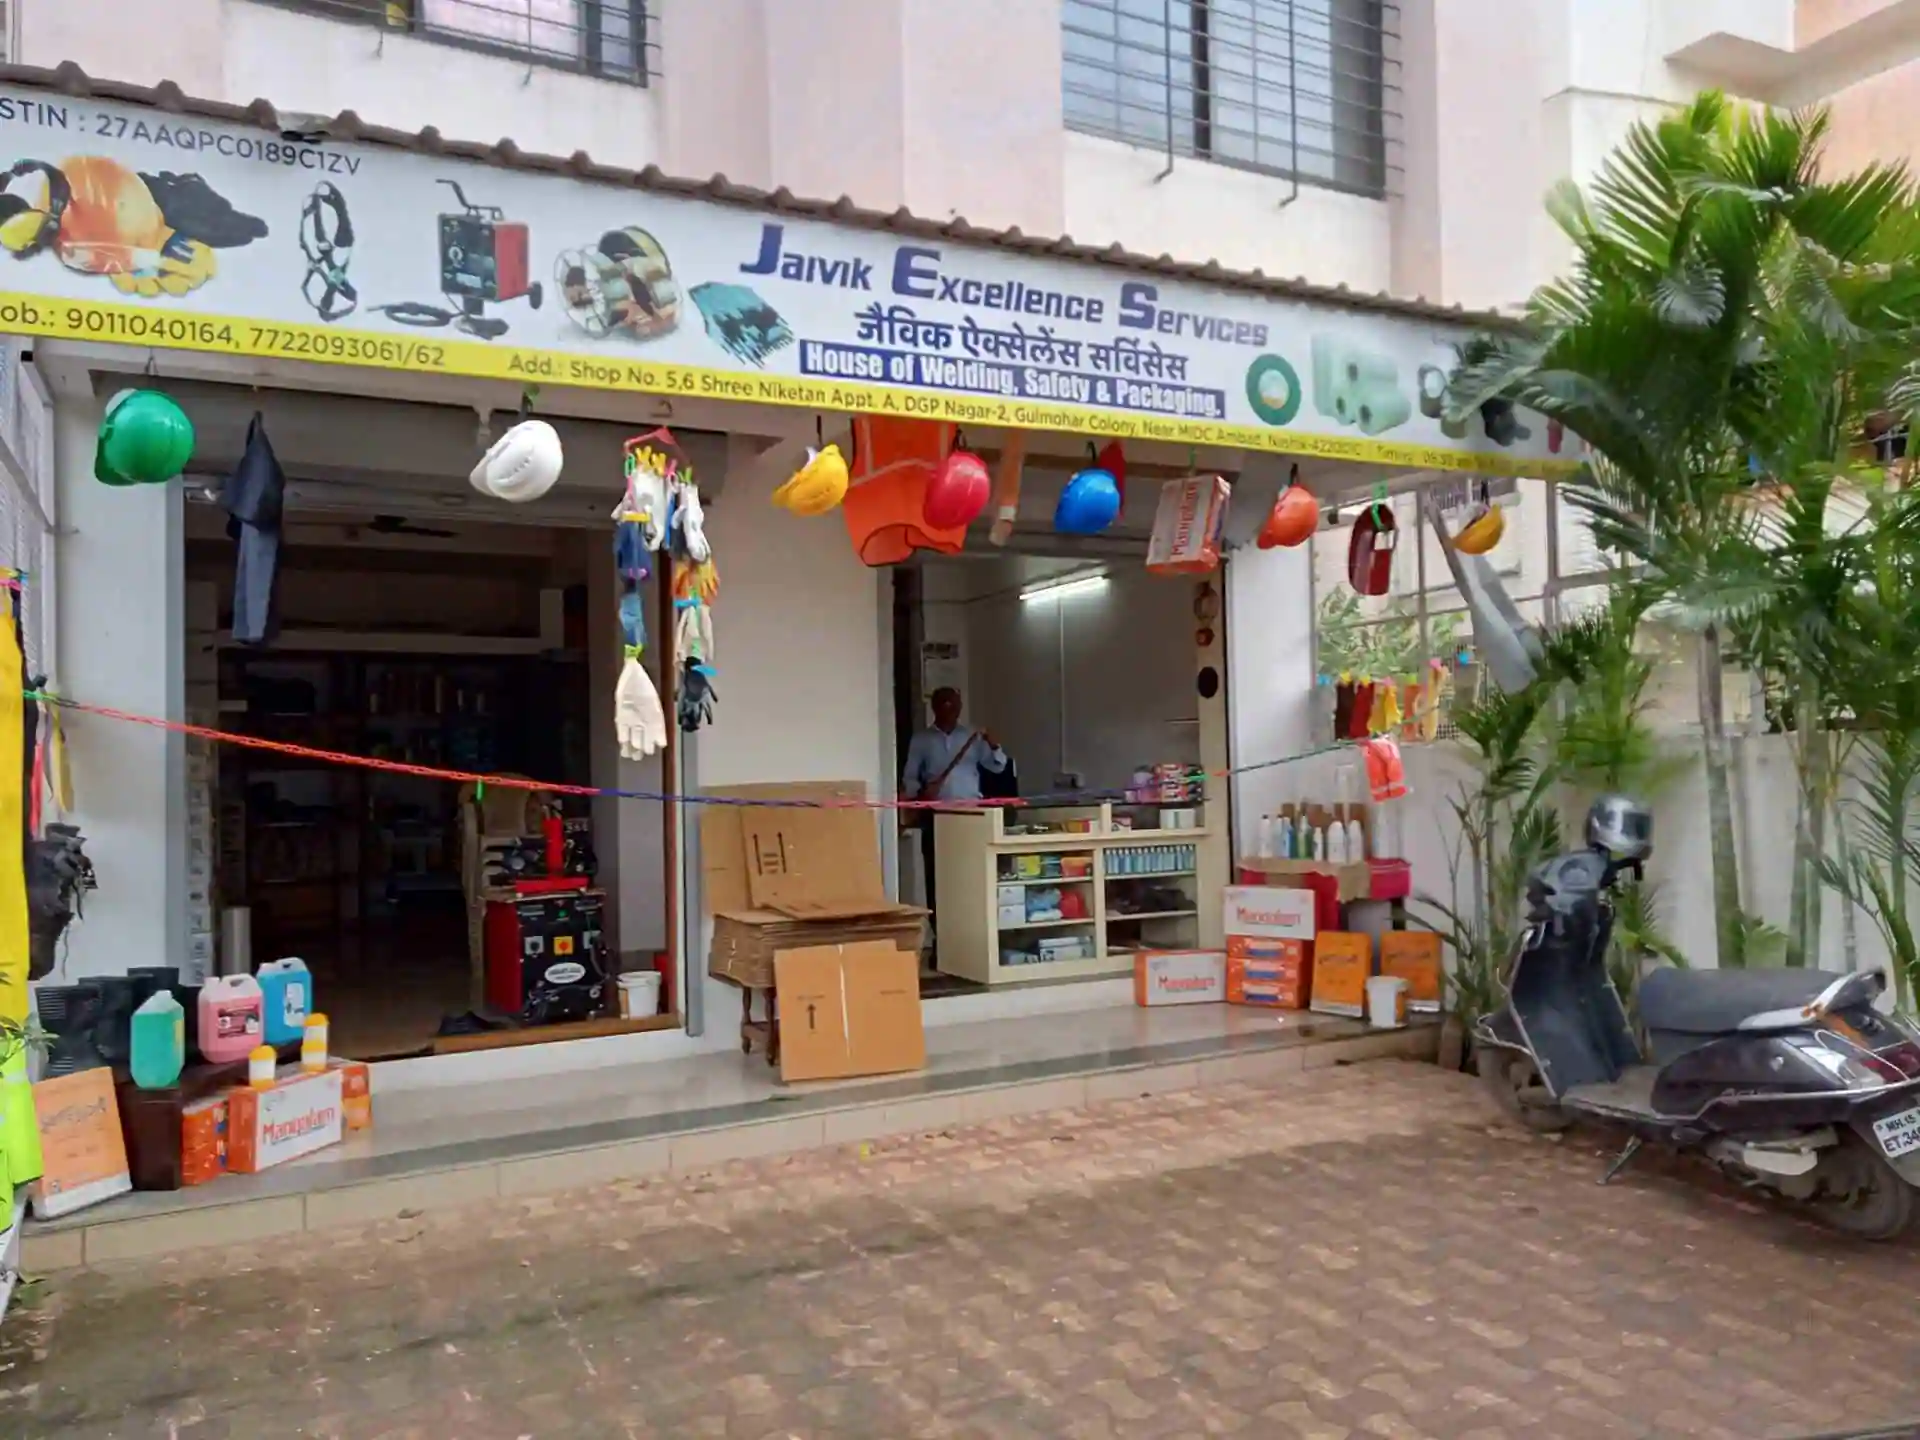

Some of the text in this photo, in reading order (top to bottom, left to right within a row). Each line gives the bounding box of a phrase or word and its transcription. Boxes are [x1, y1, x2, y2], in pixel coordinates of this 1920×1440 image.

[95, 113, 361, 175] 27AAQPC0189C1ZV
[739, 223, 1269, 347] Jaivik Excellence Services
[67, 308, 239, 348] 9011040164,
[250, 327, 444, 366] 7722093061/62
[854, 301, 1189, 381] जैविक ऐक्सेलेंस सर्विसेस
[570, 360, 621, 384] Shop
[627, 367, 661, 386] No.
[666, 370, 695, 391] 5,6
[701, 375, 753, 395] Shree
[759, 382, 826, 403] Niketan
[905, 395, 939, 413] DGP
[1015, 407, 1084, 427] Gulmohar
[806, 342, 884, 379] House
[890, 353, 915, 382] of
[1024, 368, 1090, 402] Safety
[1096, 380, 1111, 402] &
